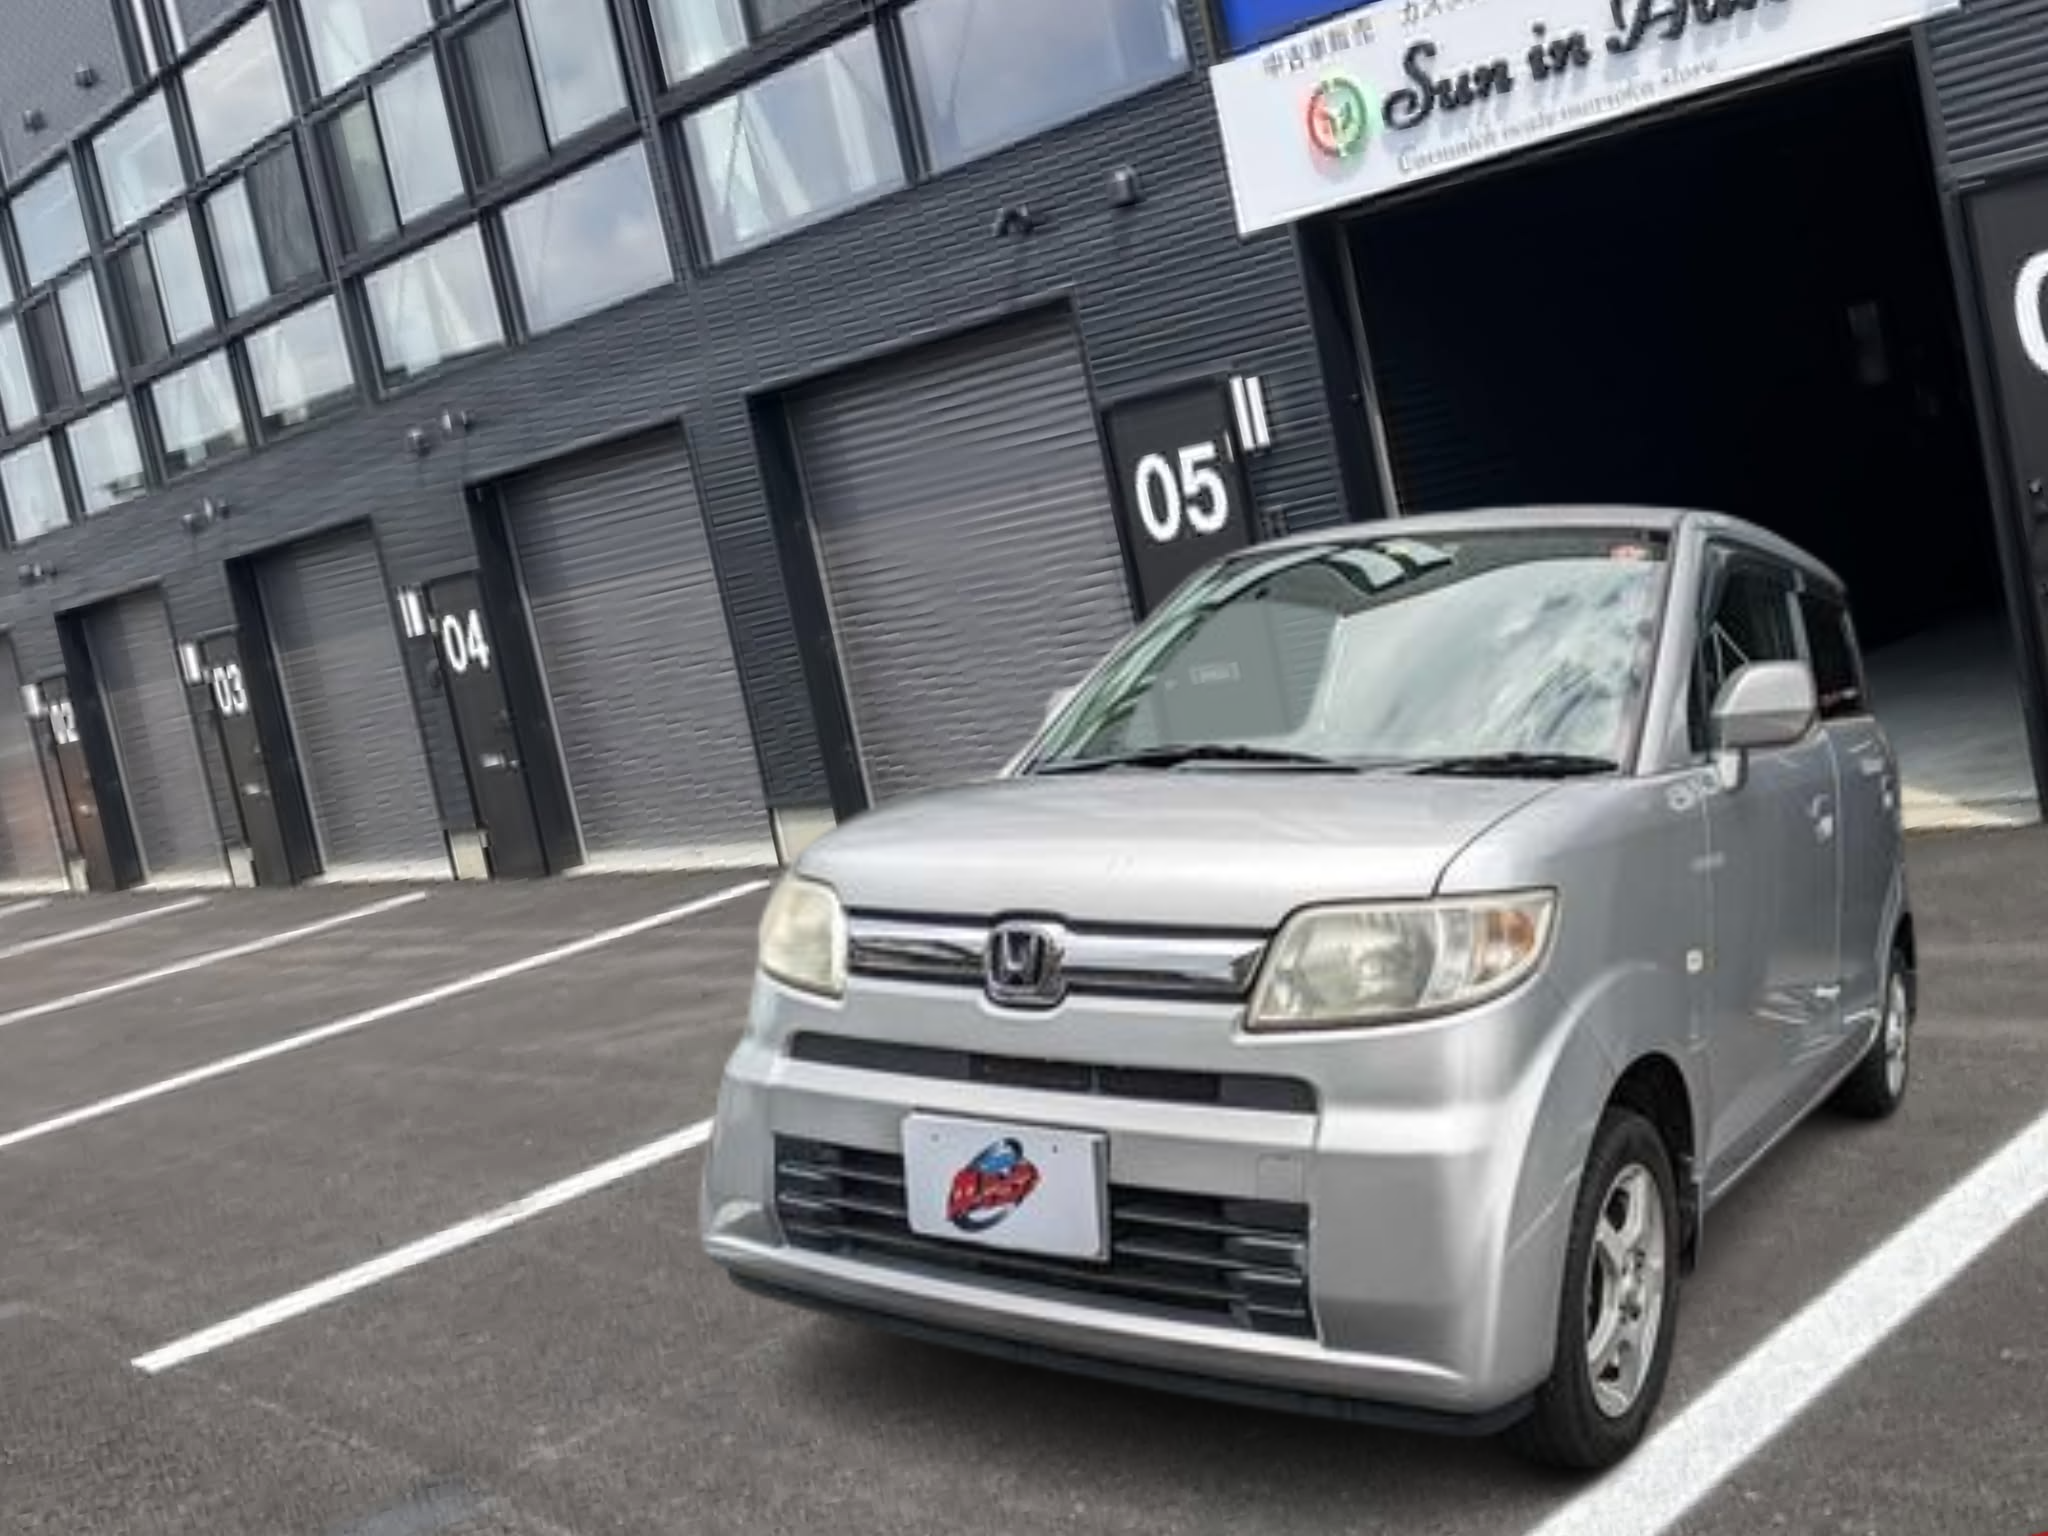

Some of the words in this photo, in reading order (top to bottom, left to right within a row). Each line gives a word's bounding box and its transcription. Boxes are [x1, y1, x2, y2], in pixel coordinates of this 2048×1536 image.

[1382, 41, 1513, 130] Sun
[1528, 22, 1589, 81] in
[1136, 441, 1229, 541] 05
[442, 609, 490, 673] 04
[212, 664, 248, 715] 03
